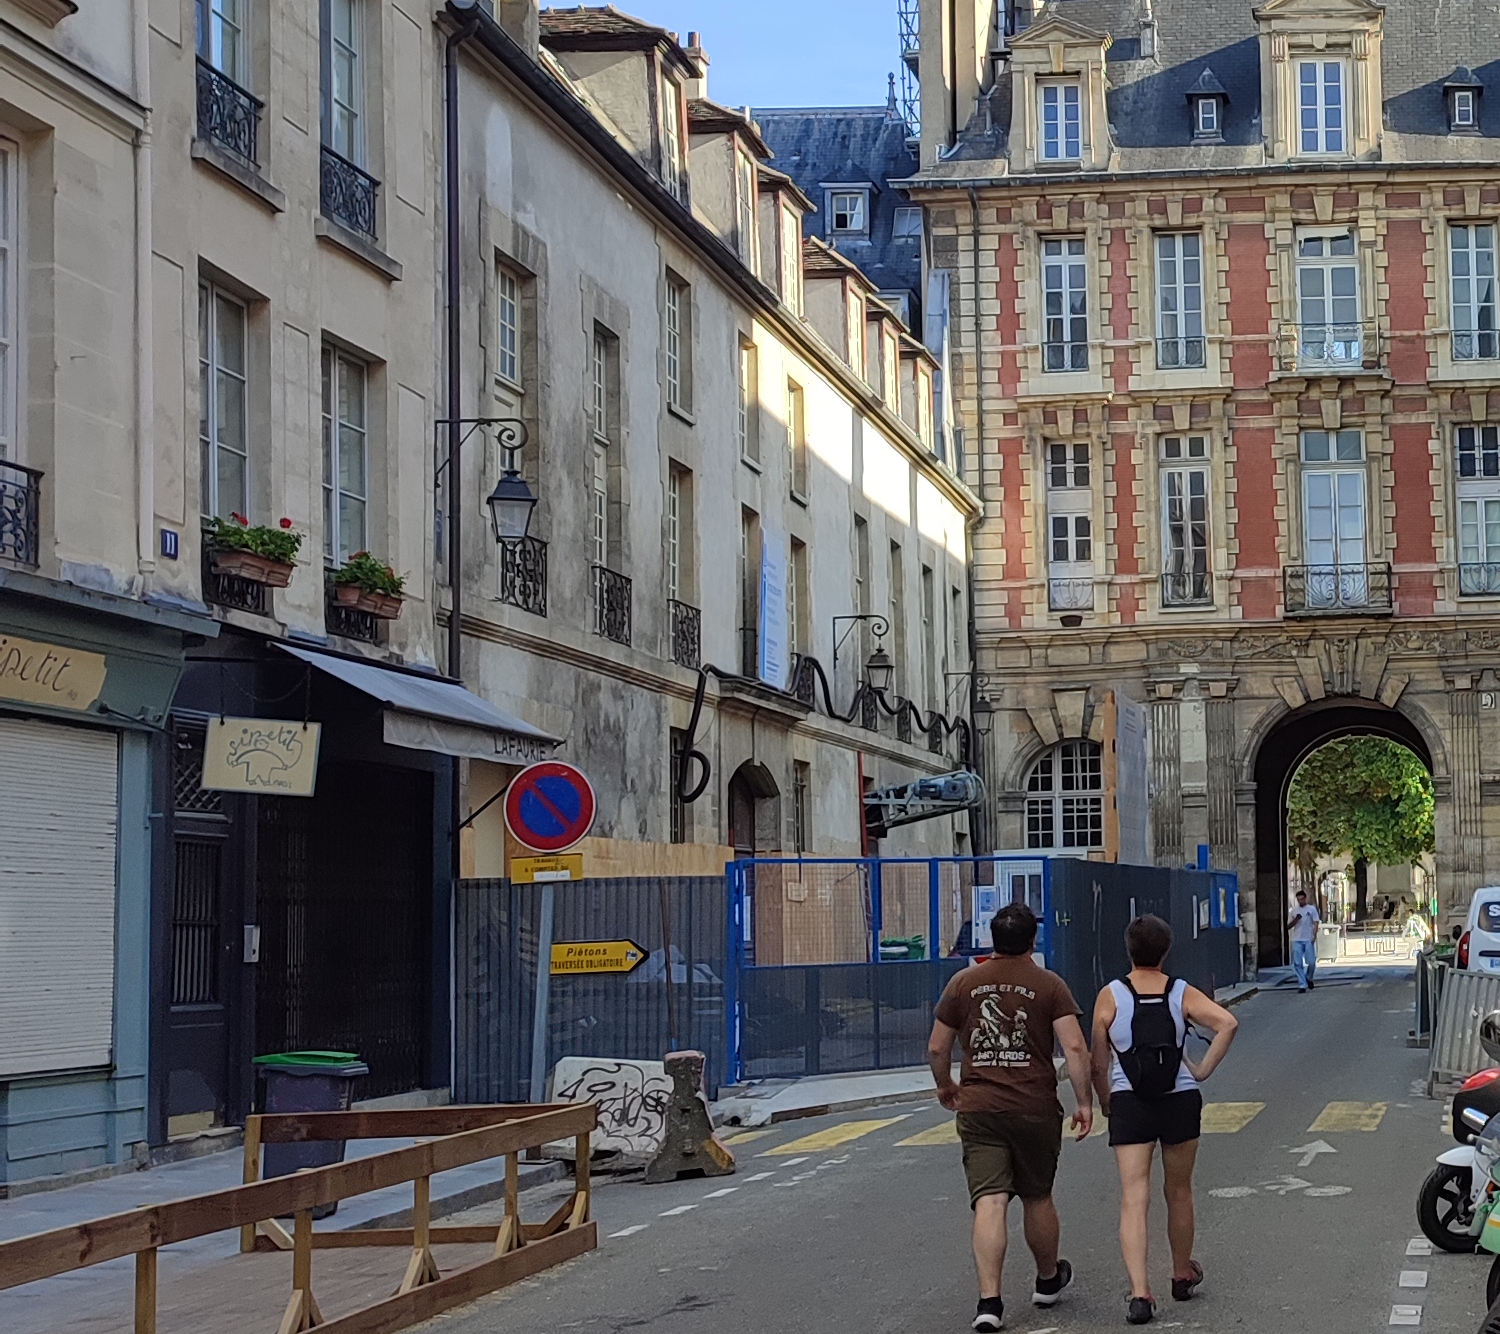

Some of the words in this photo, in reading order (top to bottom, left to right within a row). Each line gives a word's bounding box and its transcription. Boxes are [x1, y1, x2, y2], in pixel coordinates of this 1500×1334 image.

[166, 532, 175, 554] 11
[494, 734, 547, 762] LAFAURIE
[567, 948, 607, 957] Piétons
[585, 958, 623, 968] OBLIGATOIRE
[999, 984, 1013, 992] ET
